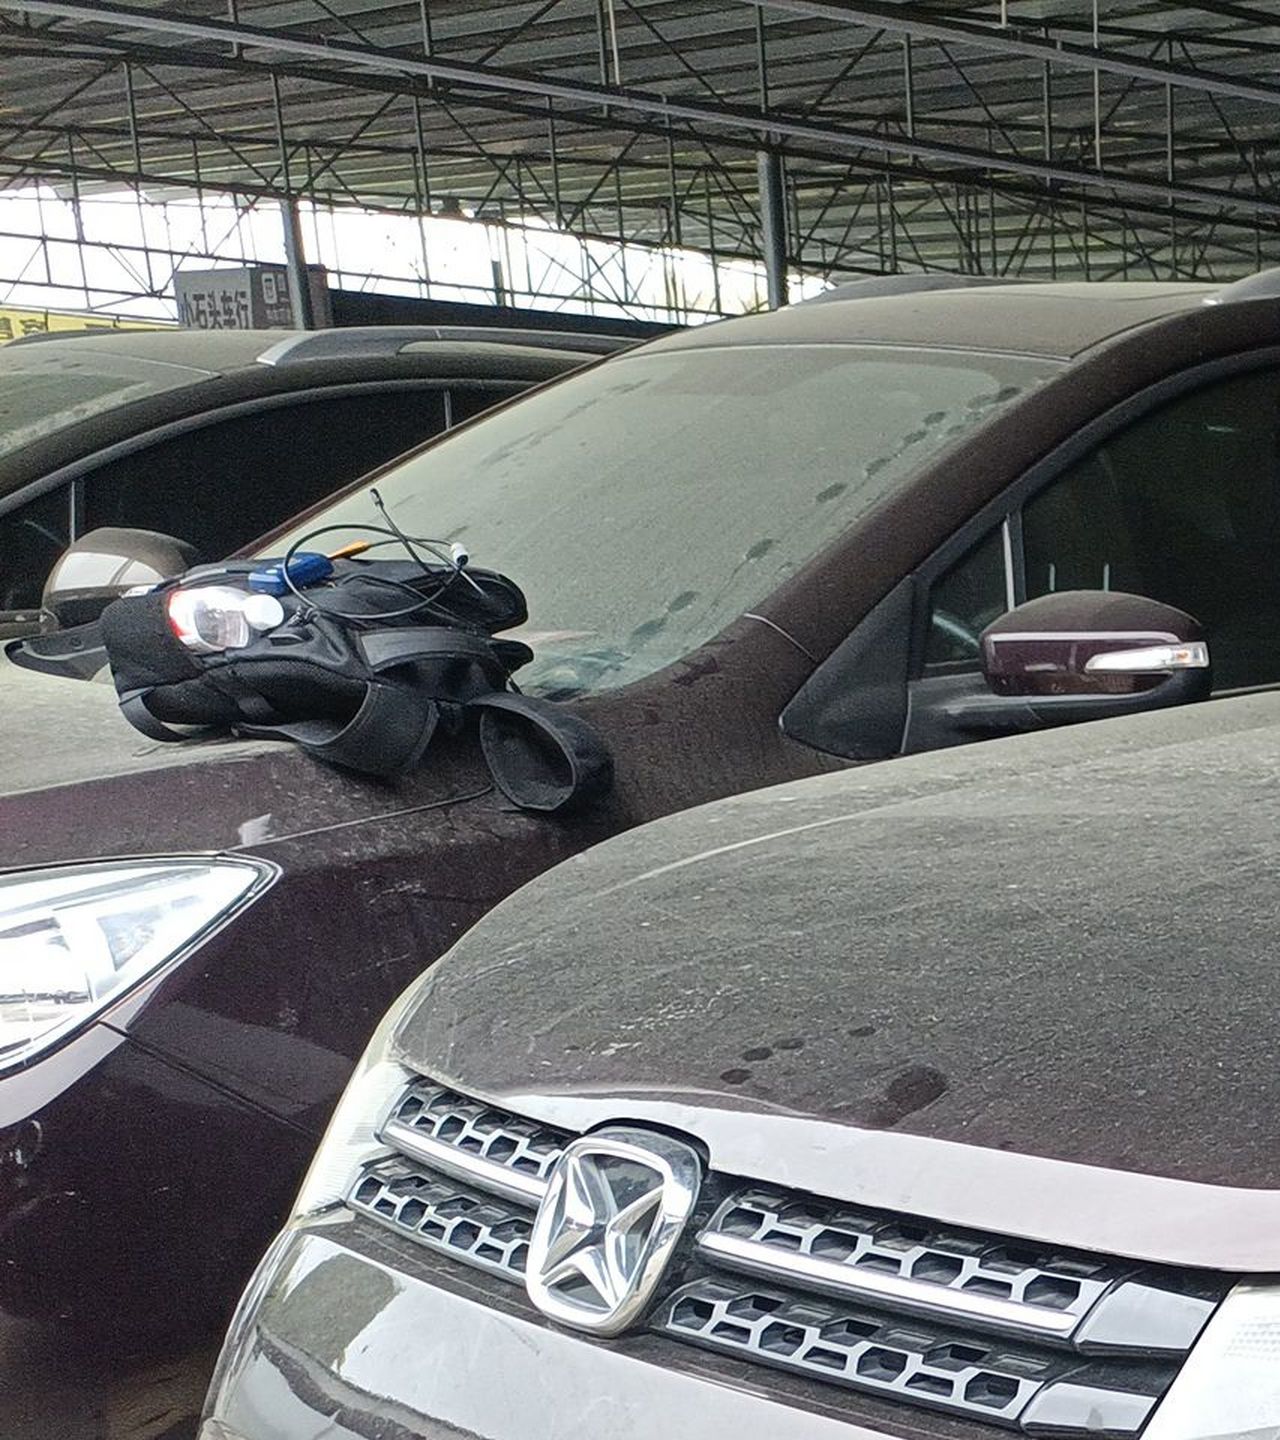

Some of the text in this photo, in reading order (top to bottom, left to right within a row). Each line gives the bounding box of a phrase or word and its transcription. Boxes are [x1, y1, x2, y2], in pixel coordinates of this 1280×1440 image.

[181, 290, 249, 329] 小石头车行
